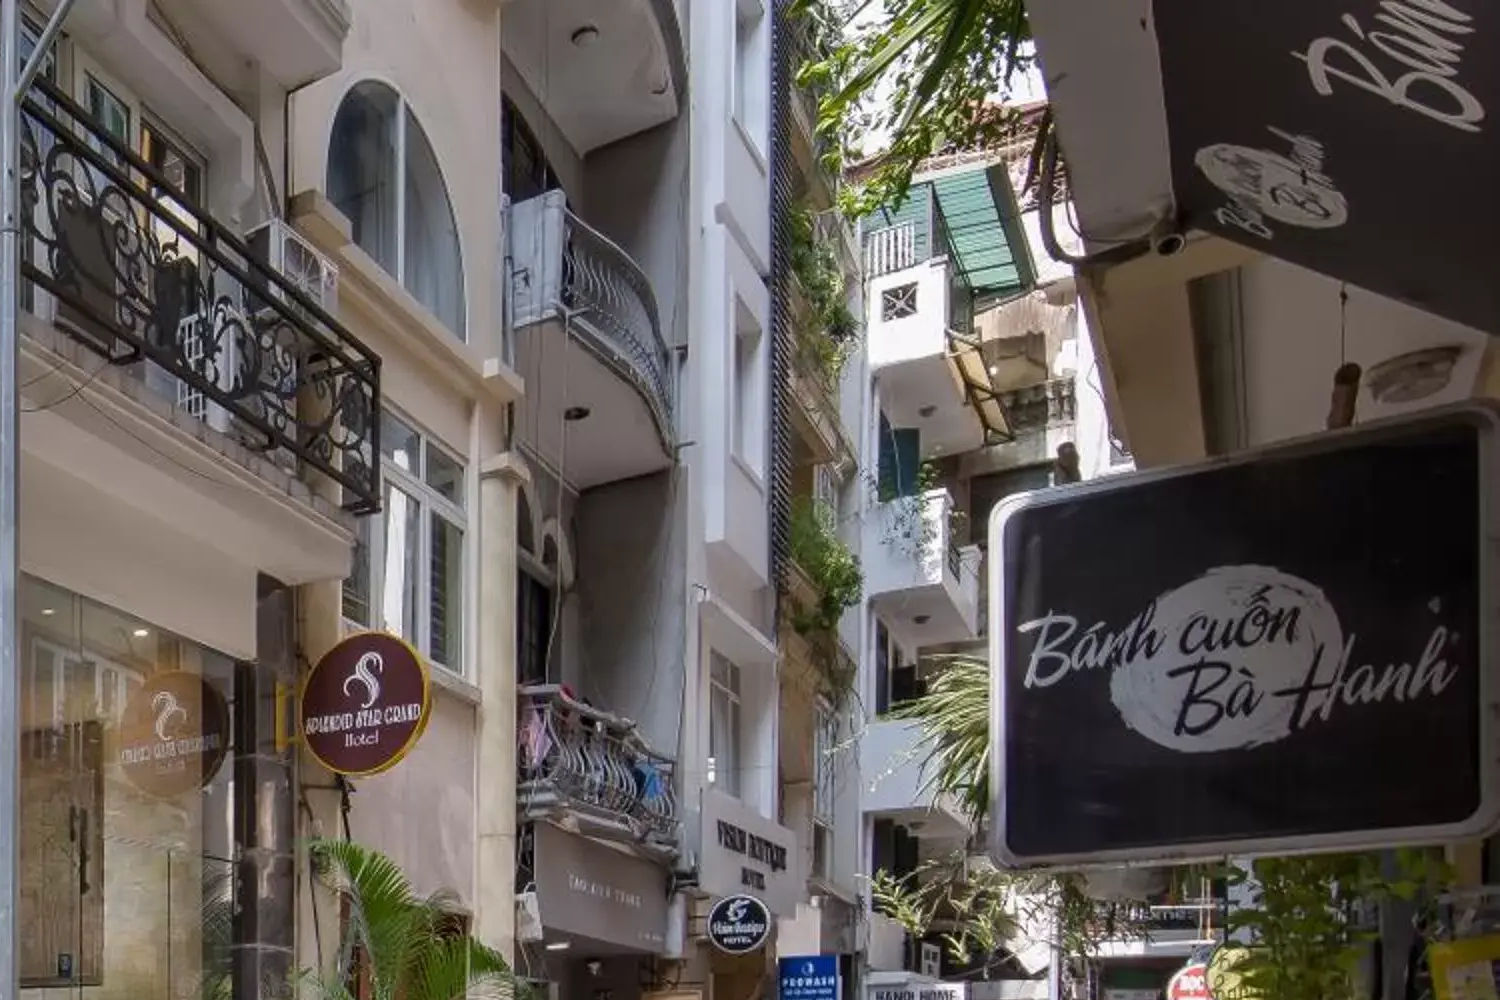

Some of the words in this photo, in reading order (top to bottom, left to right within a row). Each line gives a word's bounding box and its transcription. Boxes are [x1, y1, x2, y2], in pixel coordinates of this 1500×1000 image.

[1018, 602, 1166, 688] Bánh
[1179, 586, 1302, 654] cuốn
[1167, 656, 1266, 737] Bà
[1273, 626, 1458, 734] Hanh
[344, 729, 379, 748] Hotel
[355, 709, 382, 729] STAR
